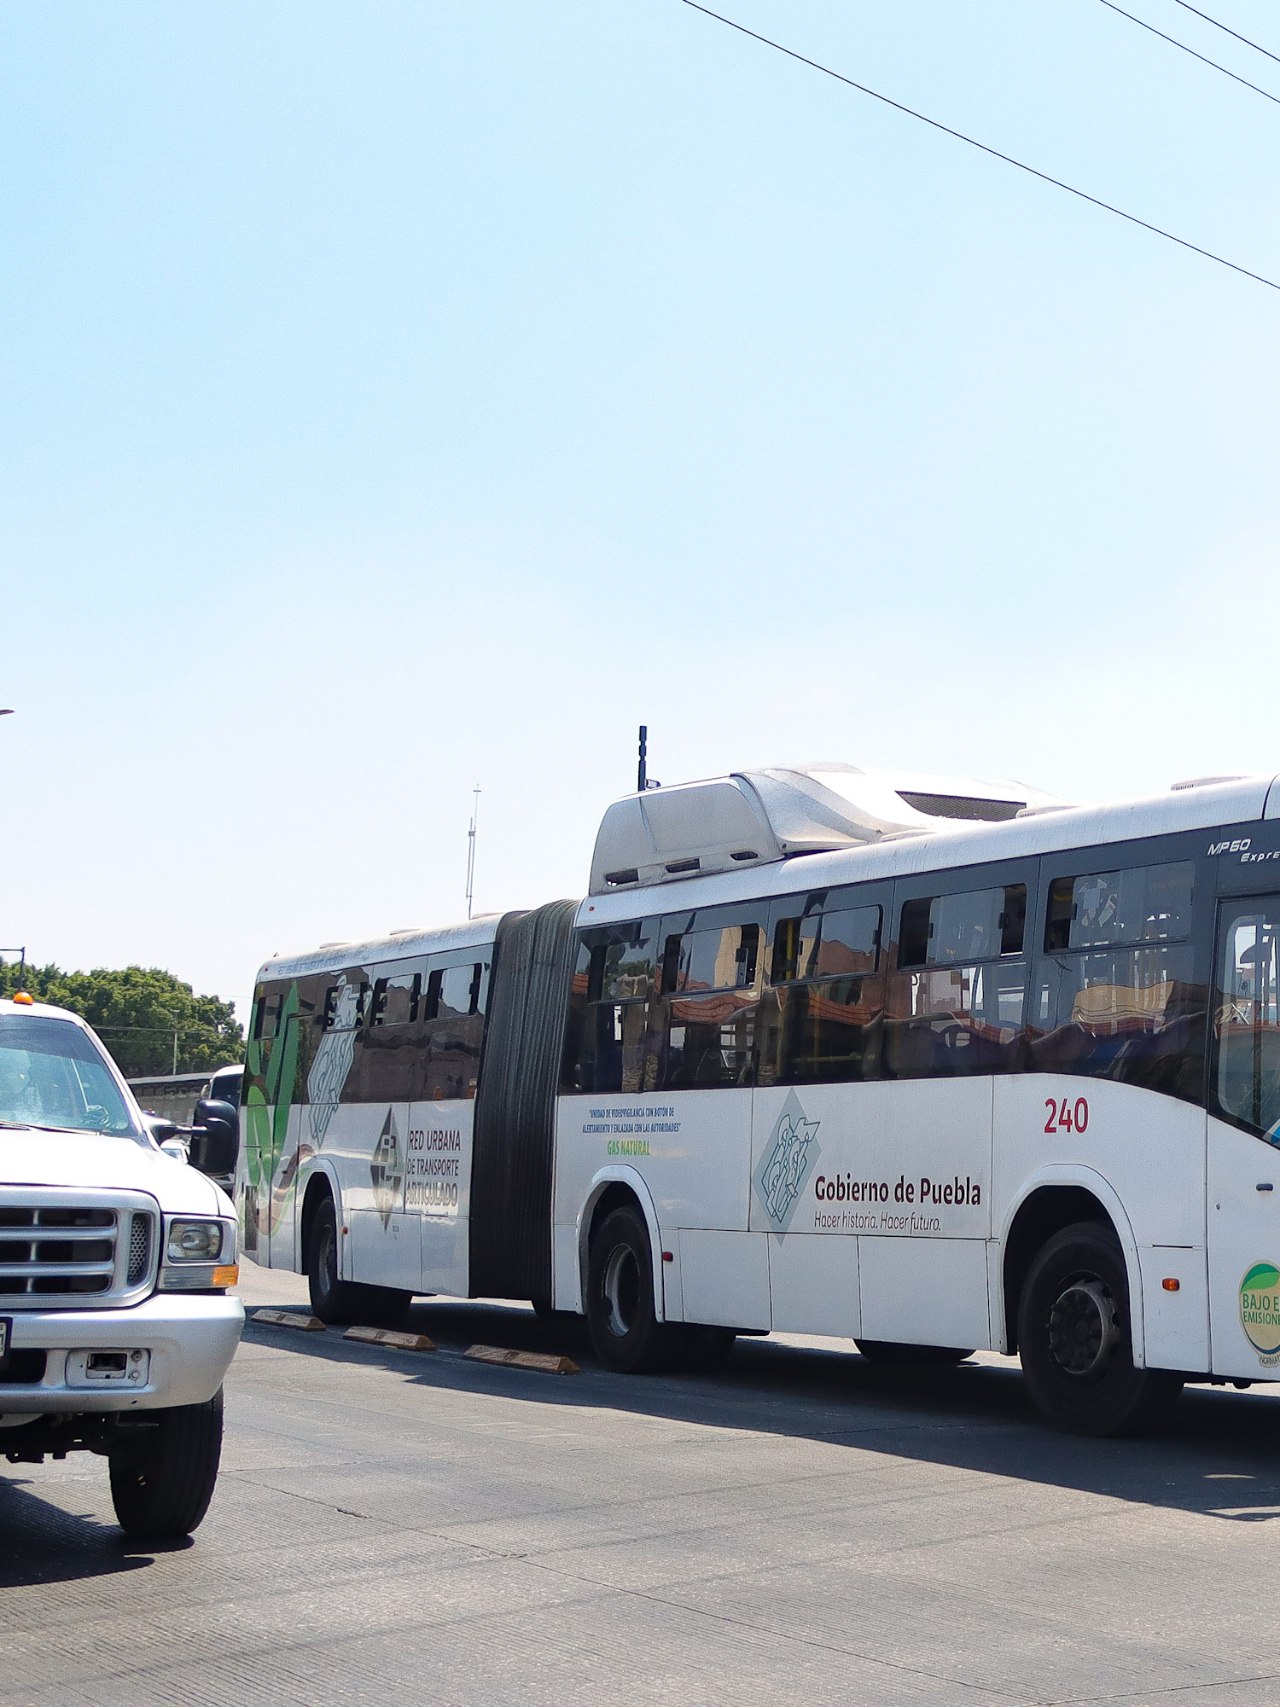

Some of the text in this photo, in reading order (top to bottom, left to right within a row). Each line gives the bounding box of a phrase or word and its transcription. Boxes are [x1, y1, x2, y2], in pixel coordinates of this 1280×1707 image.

[1207, 838, 1252, 856] MP60
[605, 1108, 612, 1118] DE
[645, 1107, 654, 1118] CON
[669, 1106, 675, 1117] DE
[1044, 1097, 1089, 1134] 240
[408, 1130, 461, 1152] RED URBANA
[607, 1139, 650, 1156] GAS NATURAL
[406, 1158, 459, 1177] DE TRANSPORTE
[406, 1181, 459, 1208] ARTICULADO
[815, 1172, 981, 1206] Gobierno de Puebla
[814, 1211, 942, 1235] Hacer historia. Hacer futuro.
[1242, 1293, 1271, 1311] BAJO
